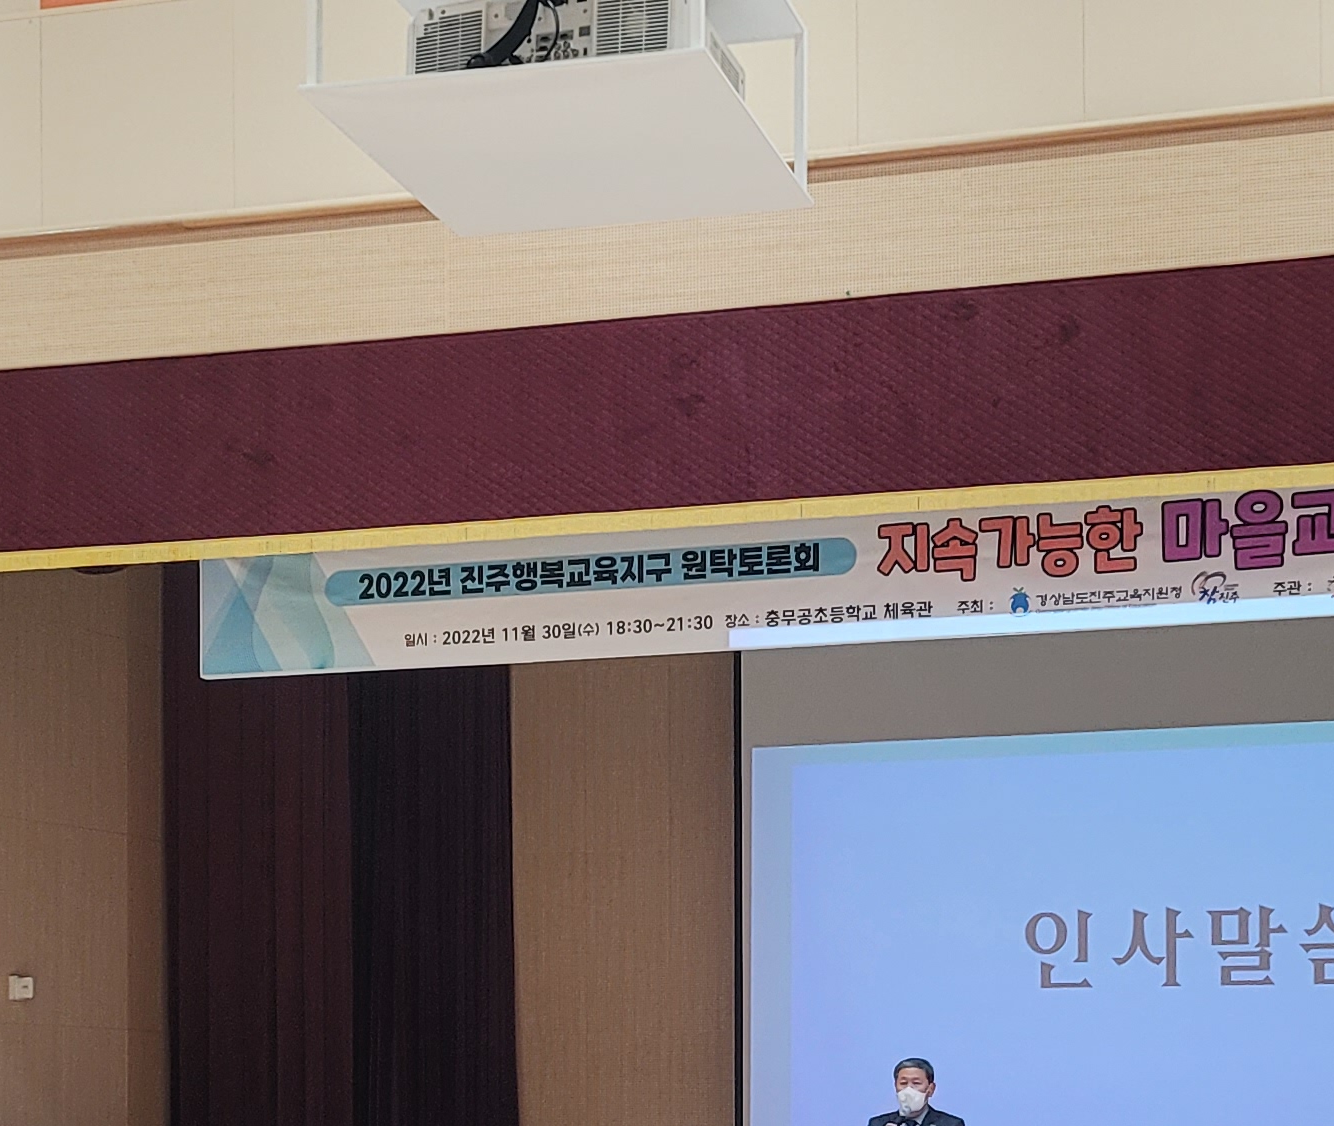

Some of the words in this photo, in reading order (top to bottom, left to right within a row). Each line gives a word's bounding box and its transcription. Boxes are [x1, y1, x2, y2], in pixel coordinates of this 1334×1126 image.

[358, 567, 452, 600] 2022년
[459, 552, 673, 595] 진주행복교육지구
[680, 542, 820, 582] 원탁토론회
[876, 504, 1144, 583] 지속가능한
[403, 632, 429, 648] 일시
[441, 626, 496, 646] 2022년
[501, 624, 536, 642] 11월
[541, 621, 601, 640] 30일(수)
[605, 614, 714, 636] 18:30~21:30
[724, 614, 751, 629] 장소
[764, 604, 877, 628] 충무공초등학교
[883, 600, 934, 620] 체육관
[956, 599, 984, 615] 주최
[1272, 580, 1302, 597] 주관
